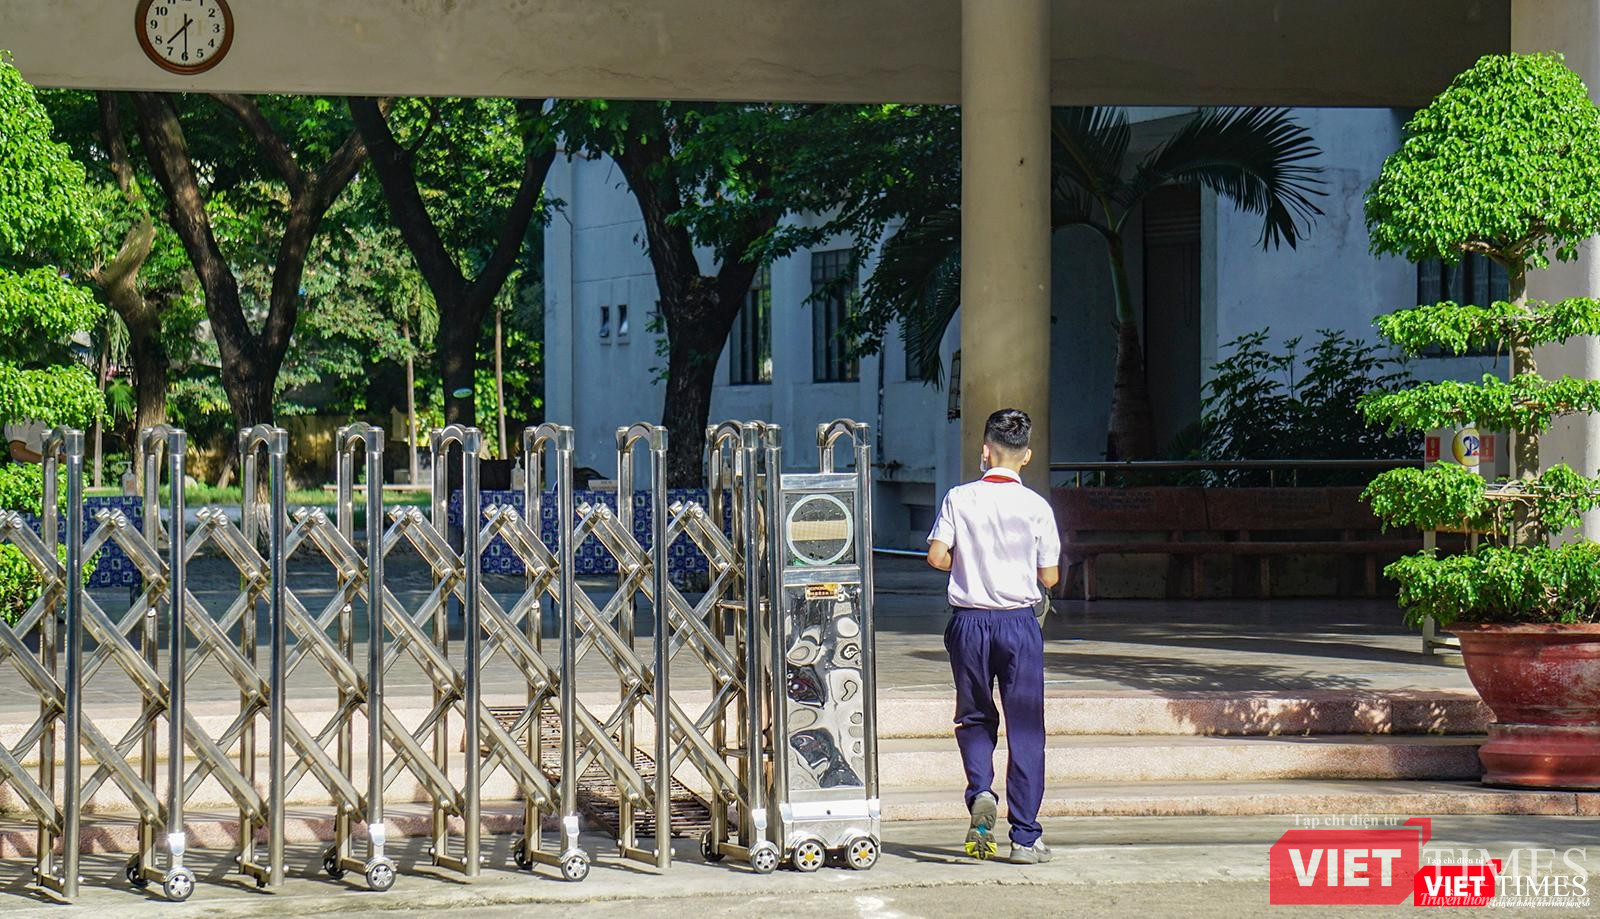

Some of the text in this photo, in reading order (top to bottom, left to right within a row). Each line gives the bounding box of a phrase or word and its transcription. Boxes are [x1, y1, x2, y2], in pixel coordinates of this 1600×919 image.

[155, 7, 168, 16] 10
[208, 8, 215, 17] 2
[150, 20, 158, 29] 9
[213, 23, 220, 33] 3
[155, 35, 163, 45] 8
[207, 38, 215, 48] 4
[166, 46, 174, 56] 7
[196, 48, 204, 58] 5
[181, 52, 189, 61] 6
